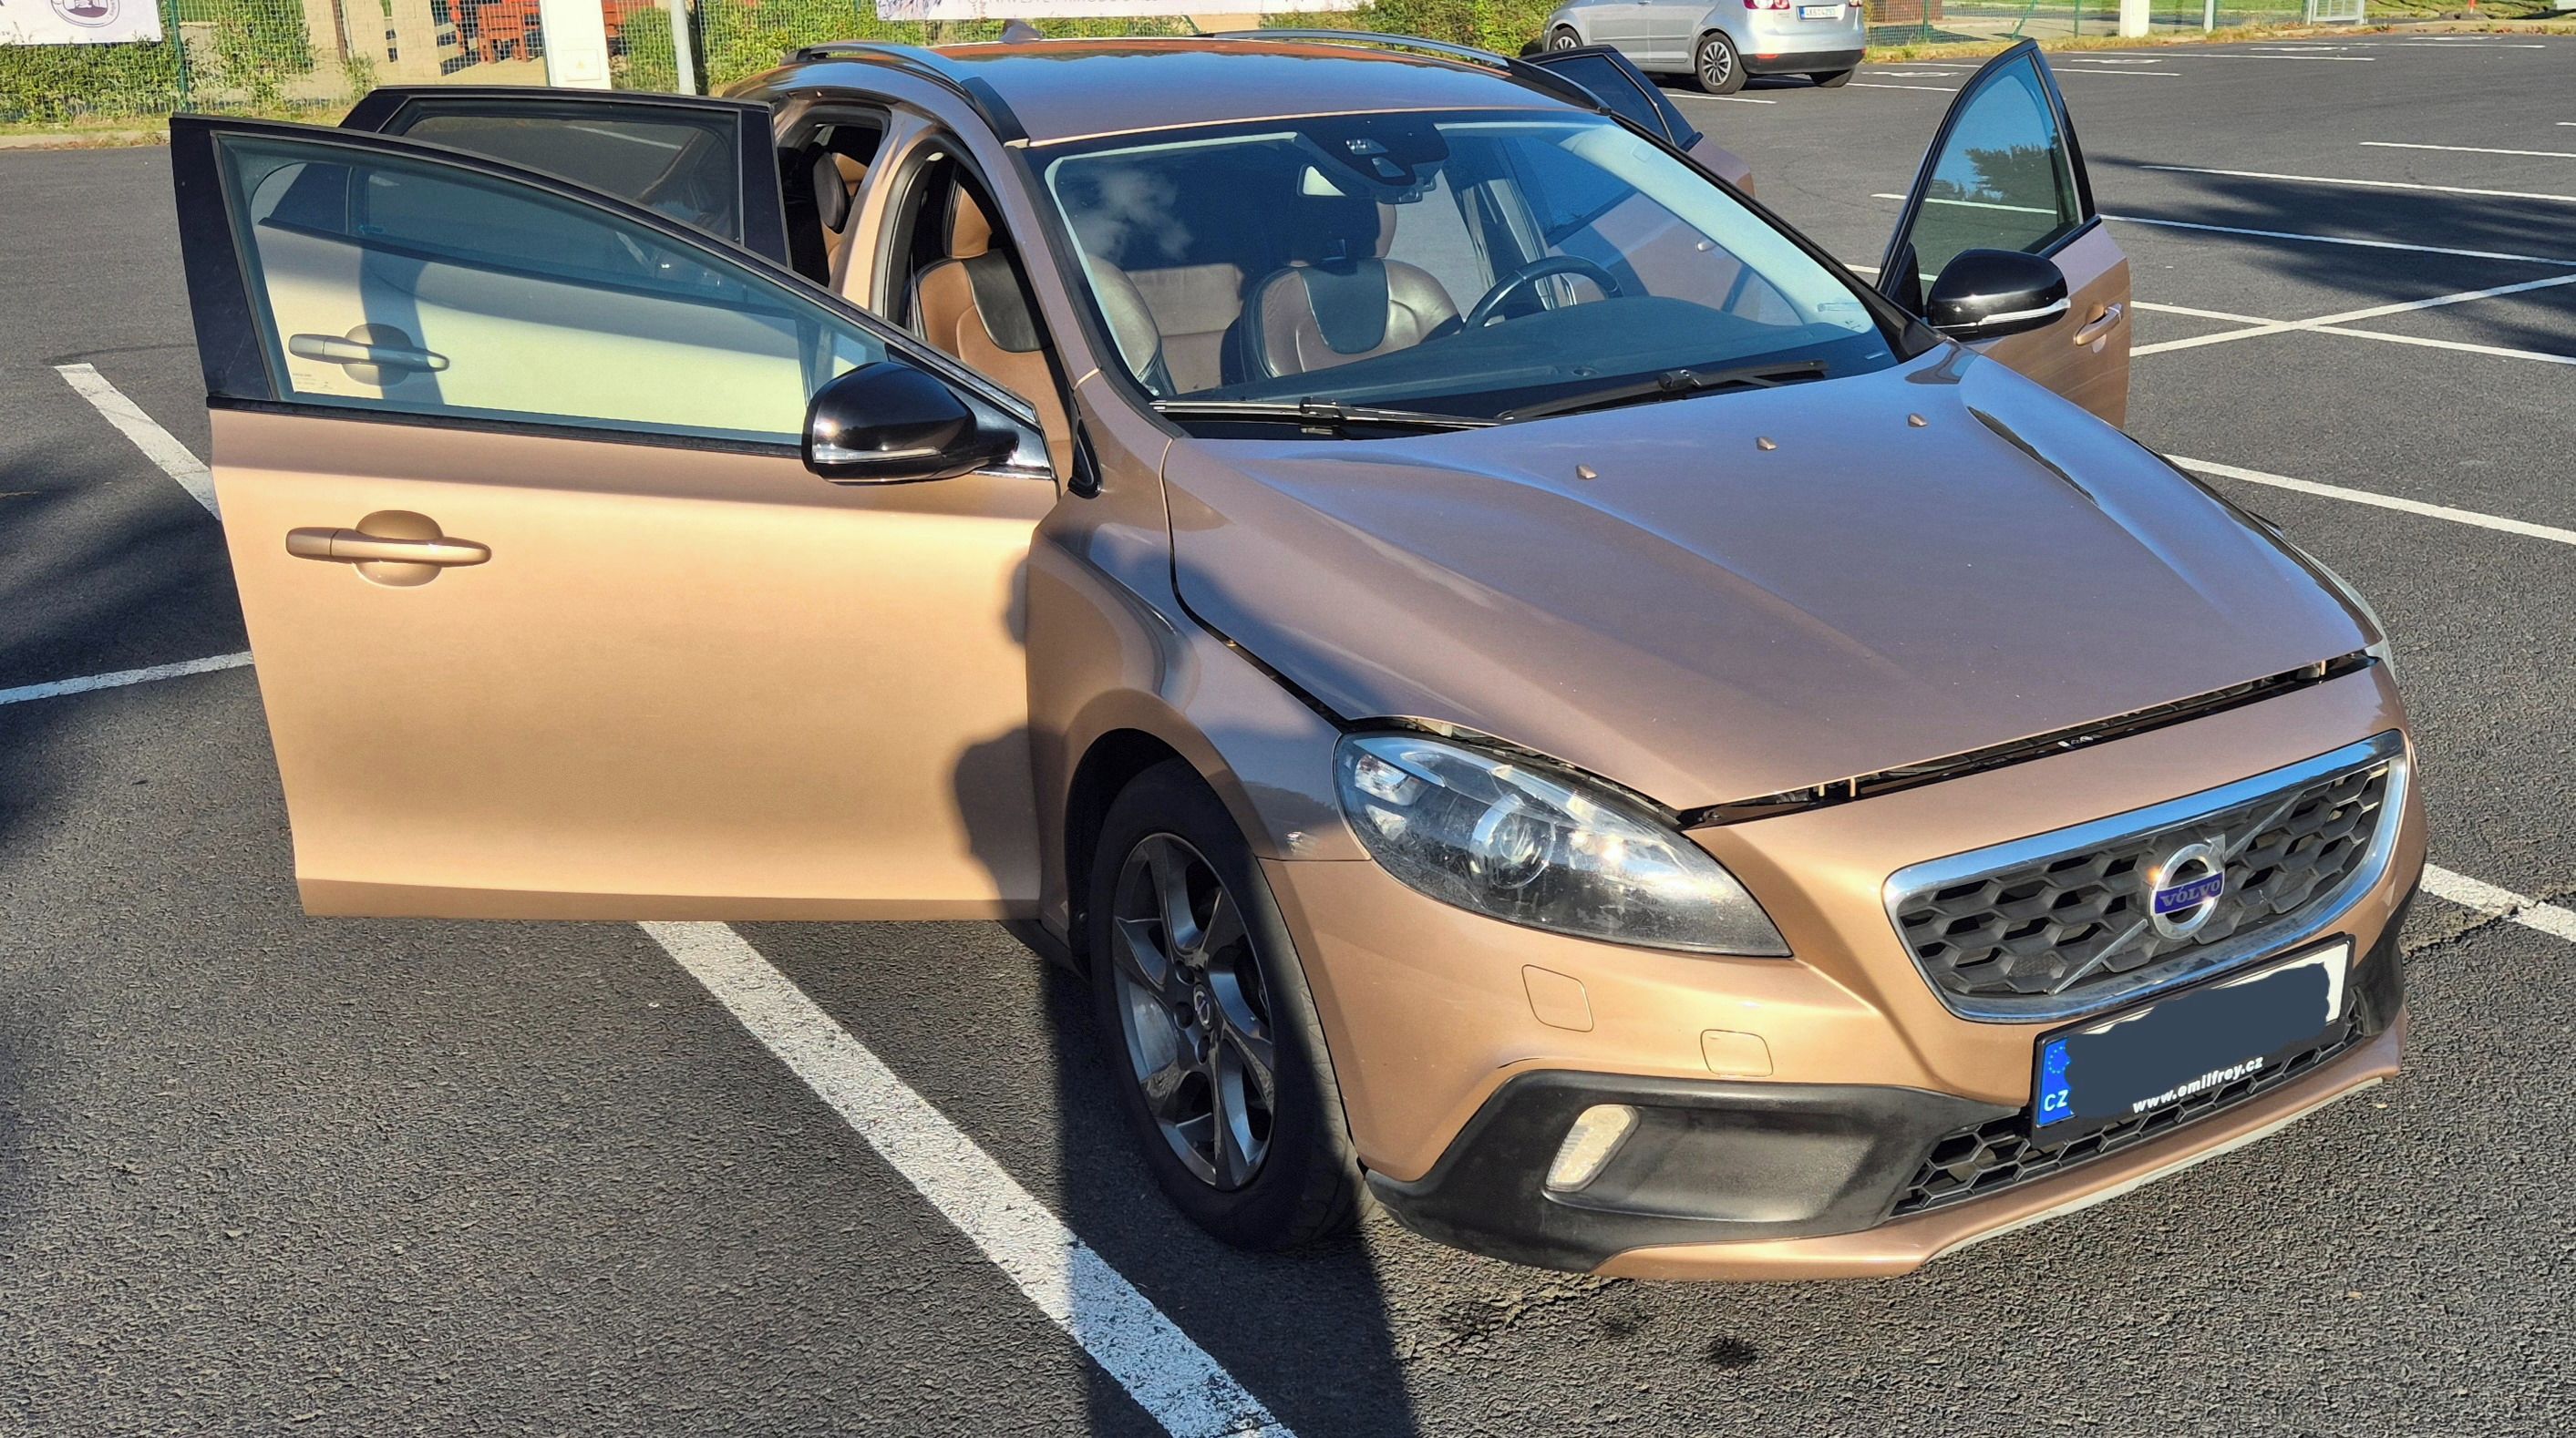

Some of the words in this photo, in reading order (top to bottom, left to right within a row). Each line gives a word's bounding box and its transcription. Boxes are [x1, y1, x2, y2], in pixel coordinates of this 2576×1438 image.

[2159, 879, 2221, 907] VOLVO
[2132, 1056, 2264, 1114] www.emilfrey.cz
[2044, 1089, 2068, 1112] CZ
